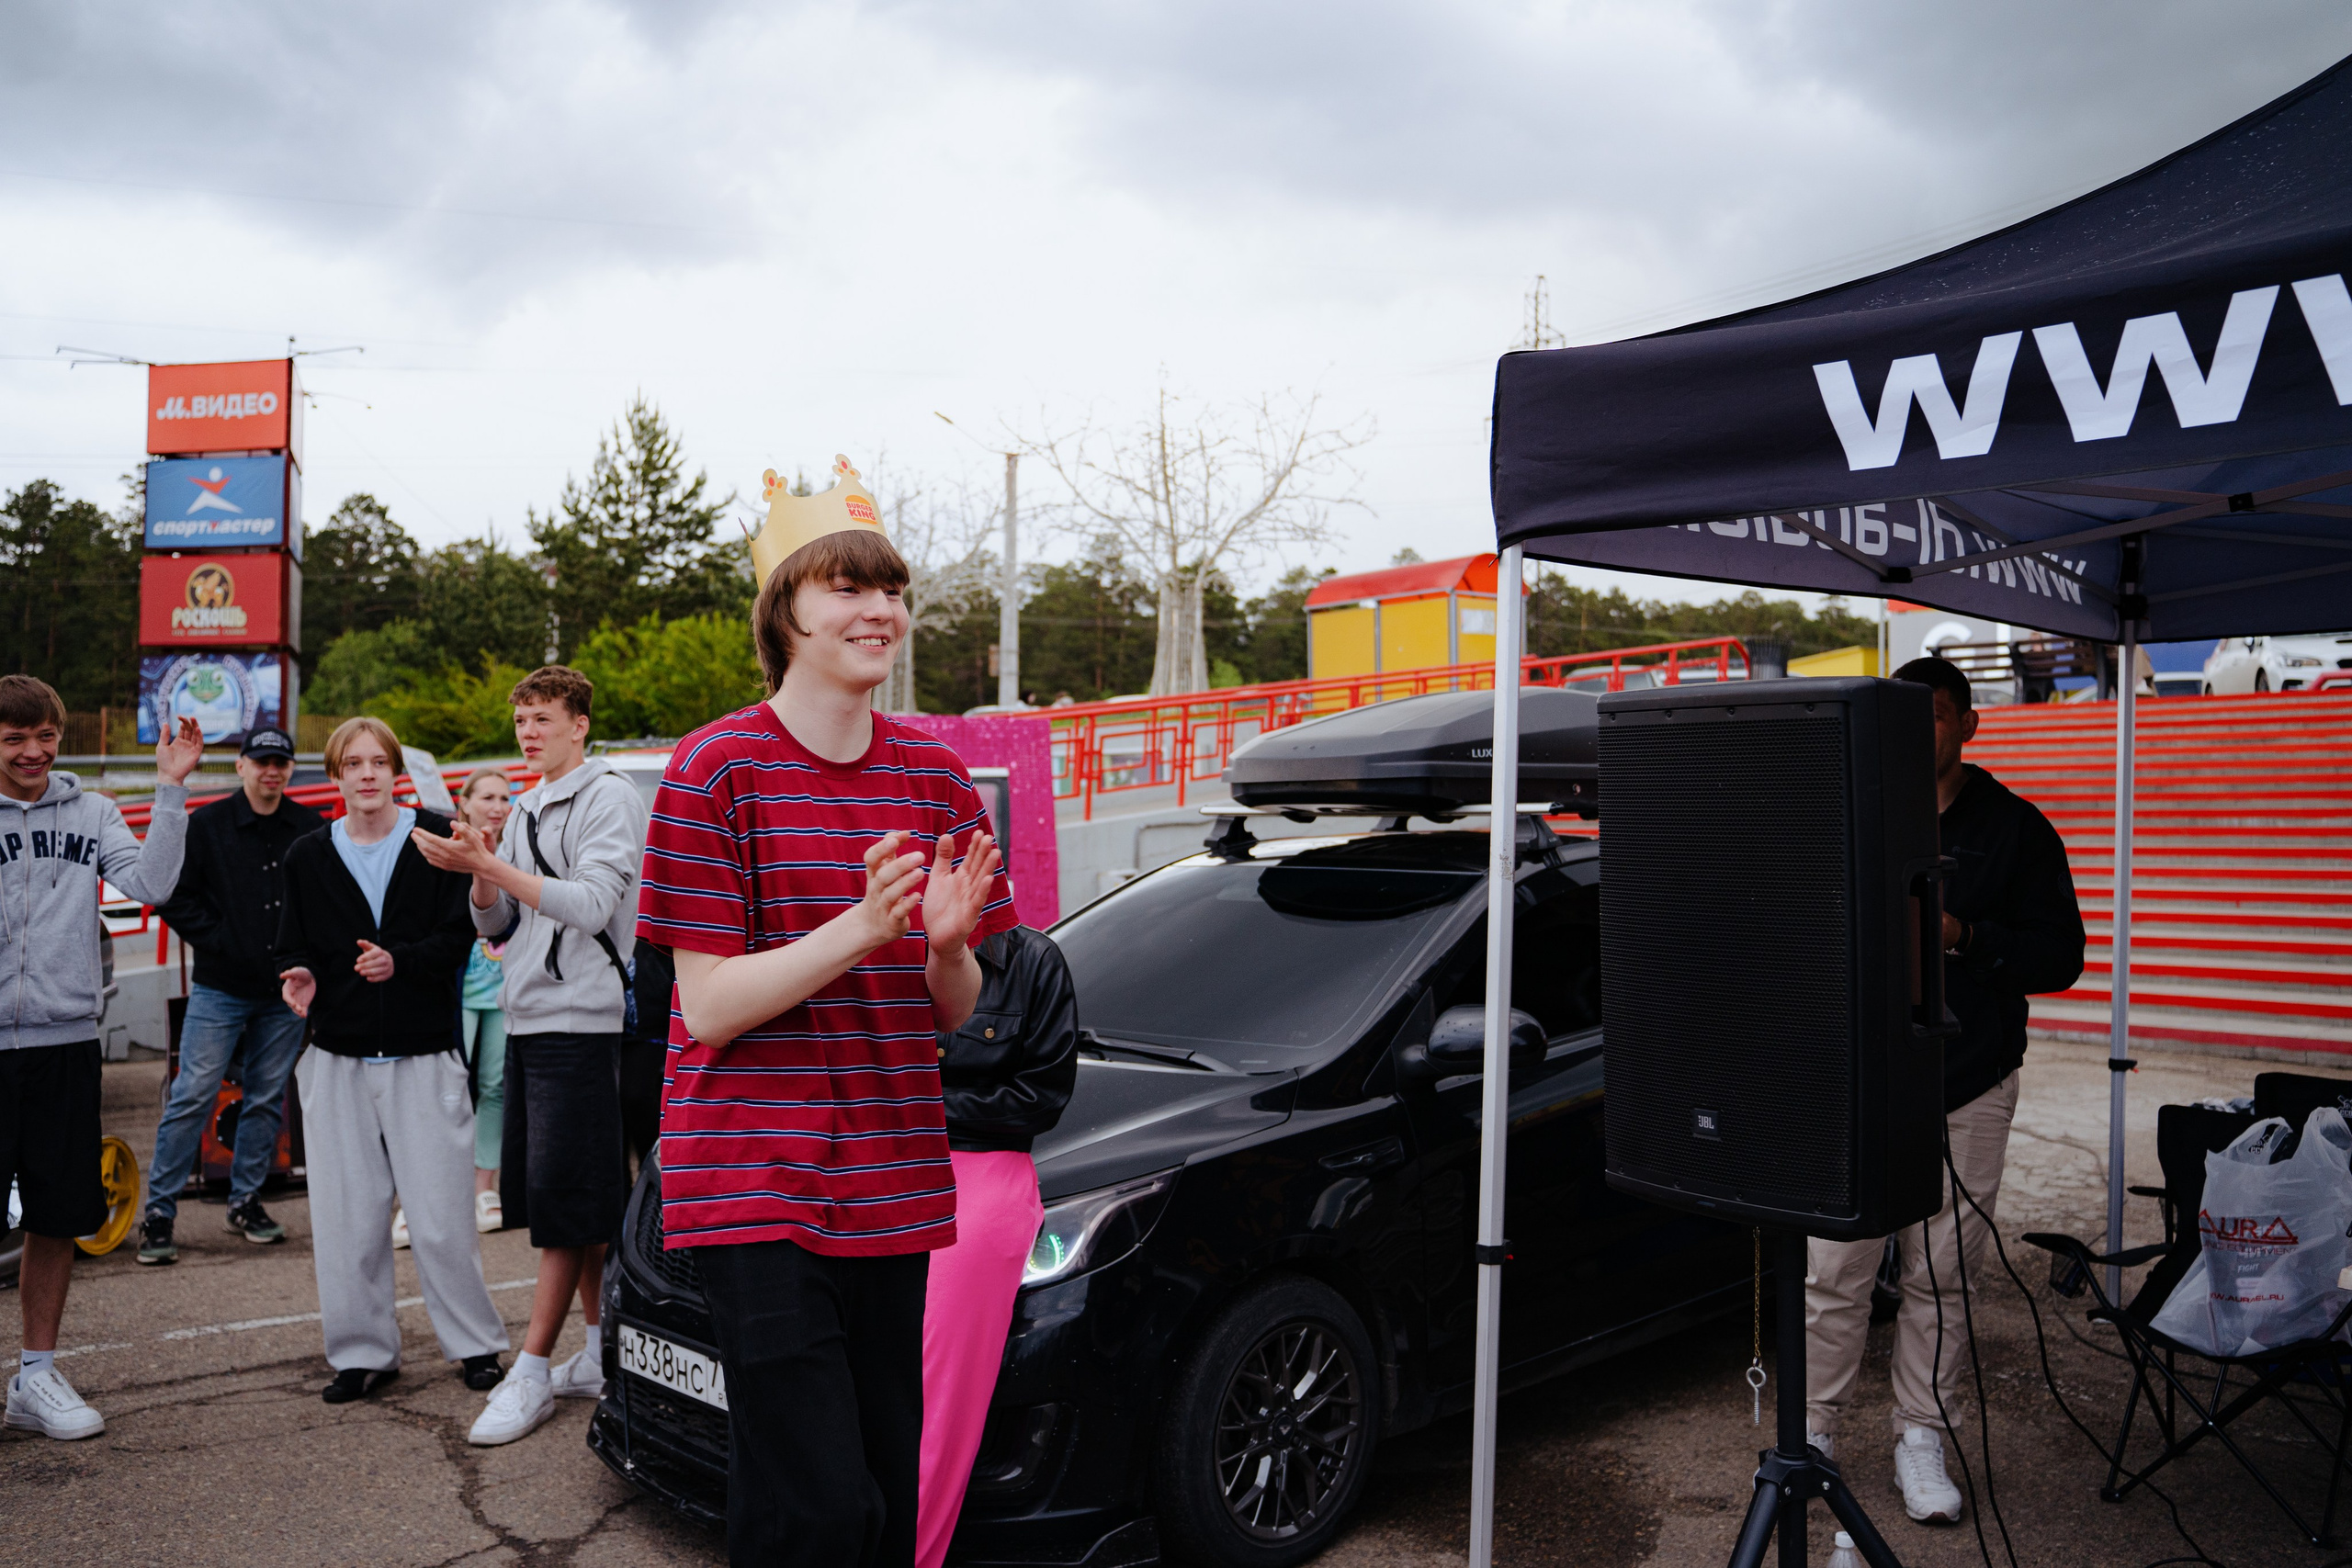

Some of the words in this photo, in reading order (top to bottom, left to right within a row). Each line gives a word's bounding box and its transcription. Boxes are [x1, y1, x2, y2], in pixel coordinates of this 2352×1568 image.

[1813, 273, 2352, 471] ww
[846, 502, 874, 513] BURGER
[848, 508, 876, 521] KING
[1472, 748, 1493, 759] LUX
[1698, 1115, 1714, 1130] JBL
